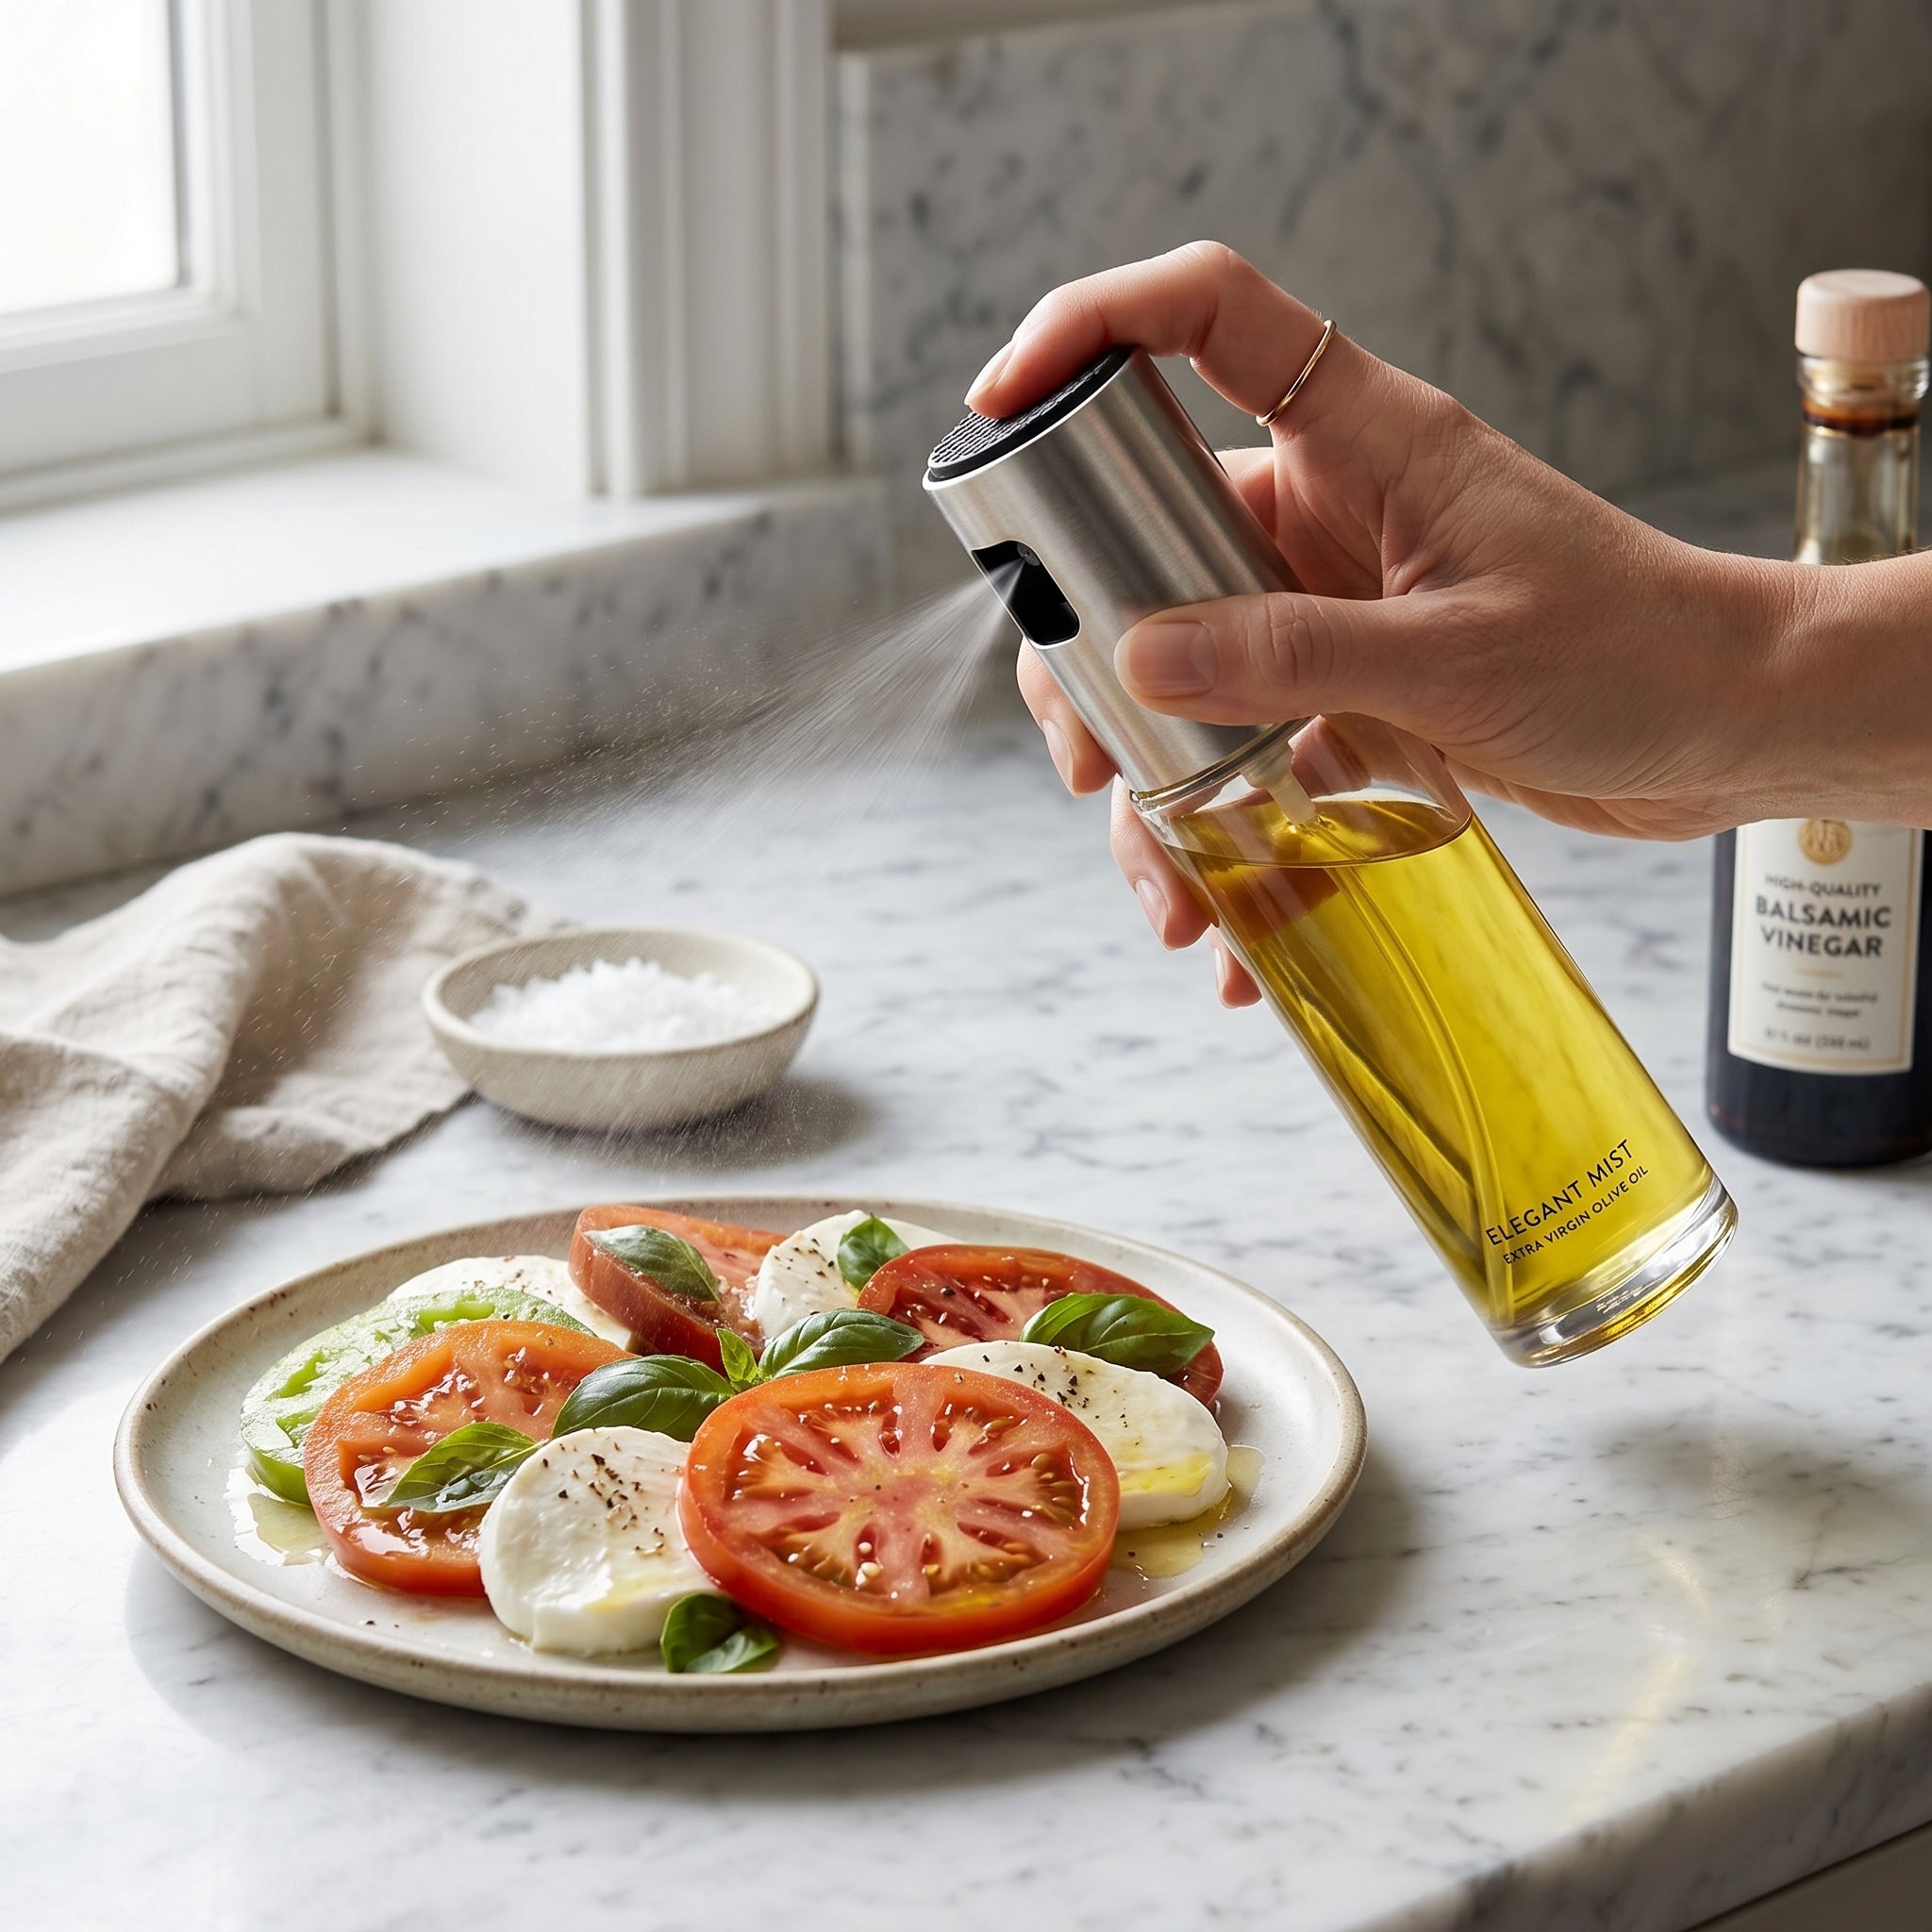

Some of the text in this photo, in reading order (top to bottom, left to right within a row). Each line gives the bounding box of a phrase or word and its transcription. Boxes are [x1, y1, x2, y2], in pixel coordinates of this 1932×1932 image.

[1765, 874, 1882, 897] HIGH-QUALITY
[1756, 895, 1892, 929] BALSAMIC
[1761, 925, 1883, 958] VINEGAR
[1485, 1139, 1633, 1245] ELEGANT MIST
[1503, 1165, 1649, 1265] EXTRA VIRGIN OLIVE OIL
